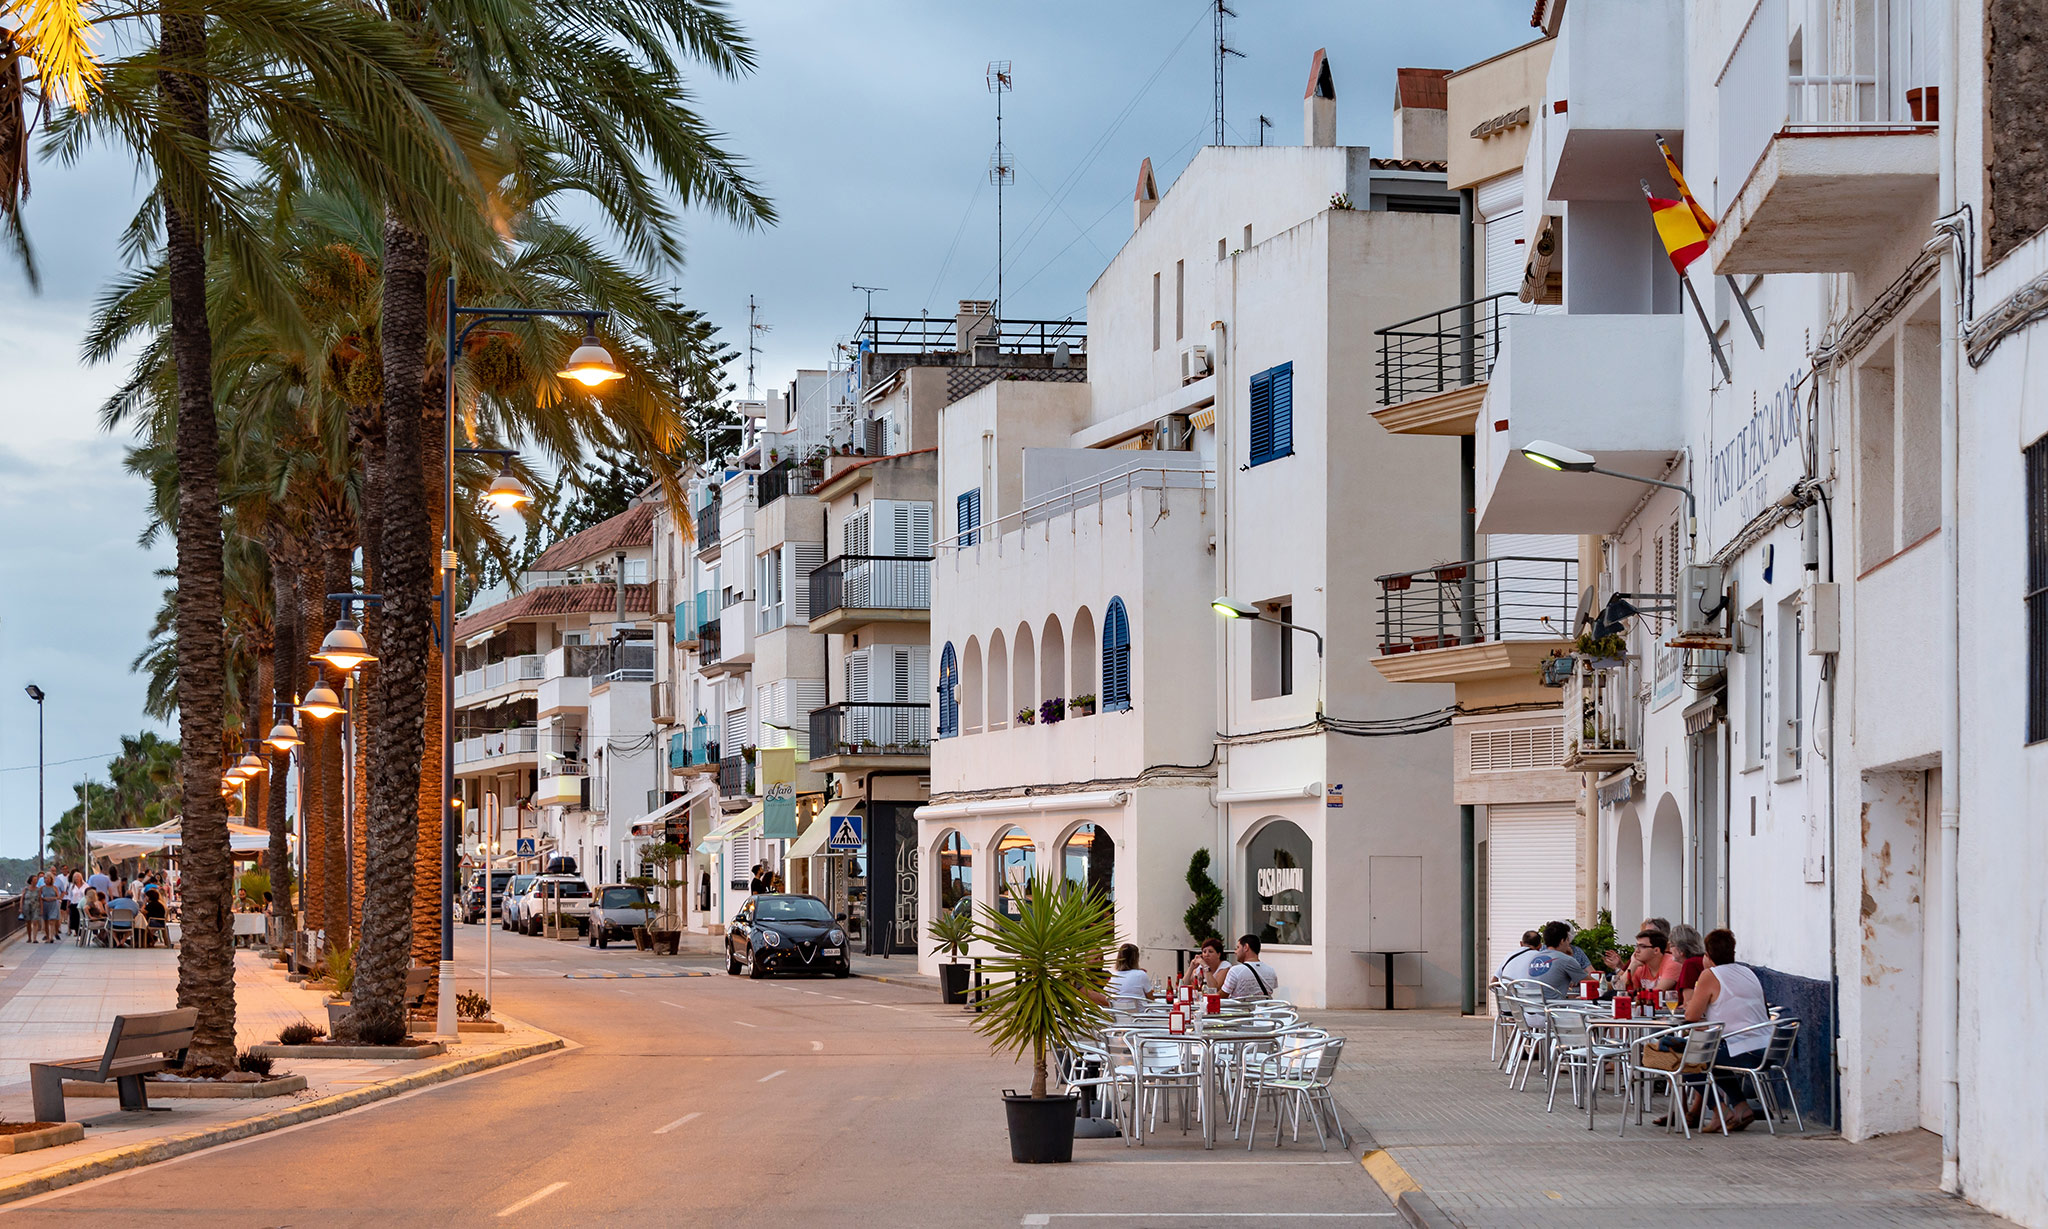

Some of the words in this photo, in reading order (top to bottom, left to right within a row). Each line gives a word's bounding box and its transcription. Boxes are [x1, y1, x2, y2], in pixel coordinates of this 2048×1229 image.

[1713, 438, 1735, 511] POSIT
[1736, 426, 1748, 491] DE
[1749, 368, 1802, 479] PESCADORS
[1258, 868, 1276, 897] CASA
[1262, 904, 1300, 912] RESTAURANT
